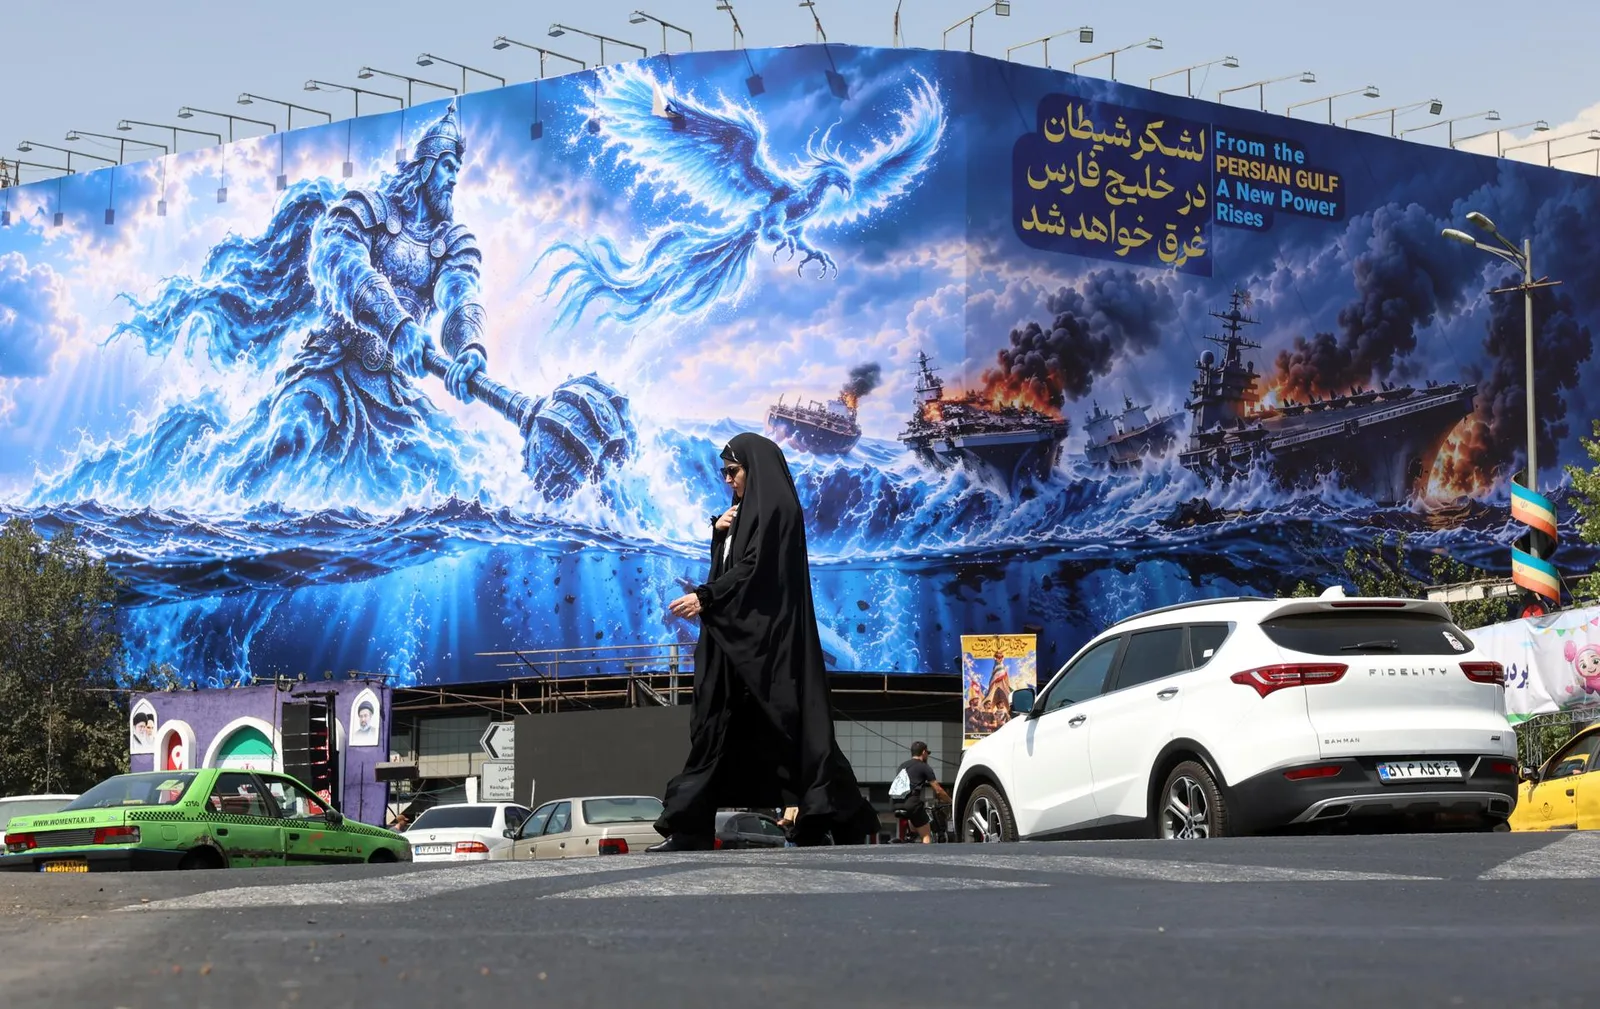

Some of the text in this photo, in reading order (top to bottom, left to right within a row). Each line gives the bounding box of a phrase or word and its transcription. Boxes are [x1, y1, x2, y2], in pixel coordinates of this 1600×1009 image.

[1044, 102, 1206, 162] لشکر شیطان
[1215, 131, 1305, 164] From the
[1027, 150, 1207, 216] در خلیج فارس
[1216, 154, 1339, 194] PERSIAN GULF
[1216, 178, 1337, 217] A New Power
[1216, 202, 1264, 228] Rises
[1021, 204, 1207, 266] غرق خواهد شد
[1368, 667, 1447, 677] FIDELITY
[32, 816, 96, 828] WWW.WOMENTAXI.IR
